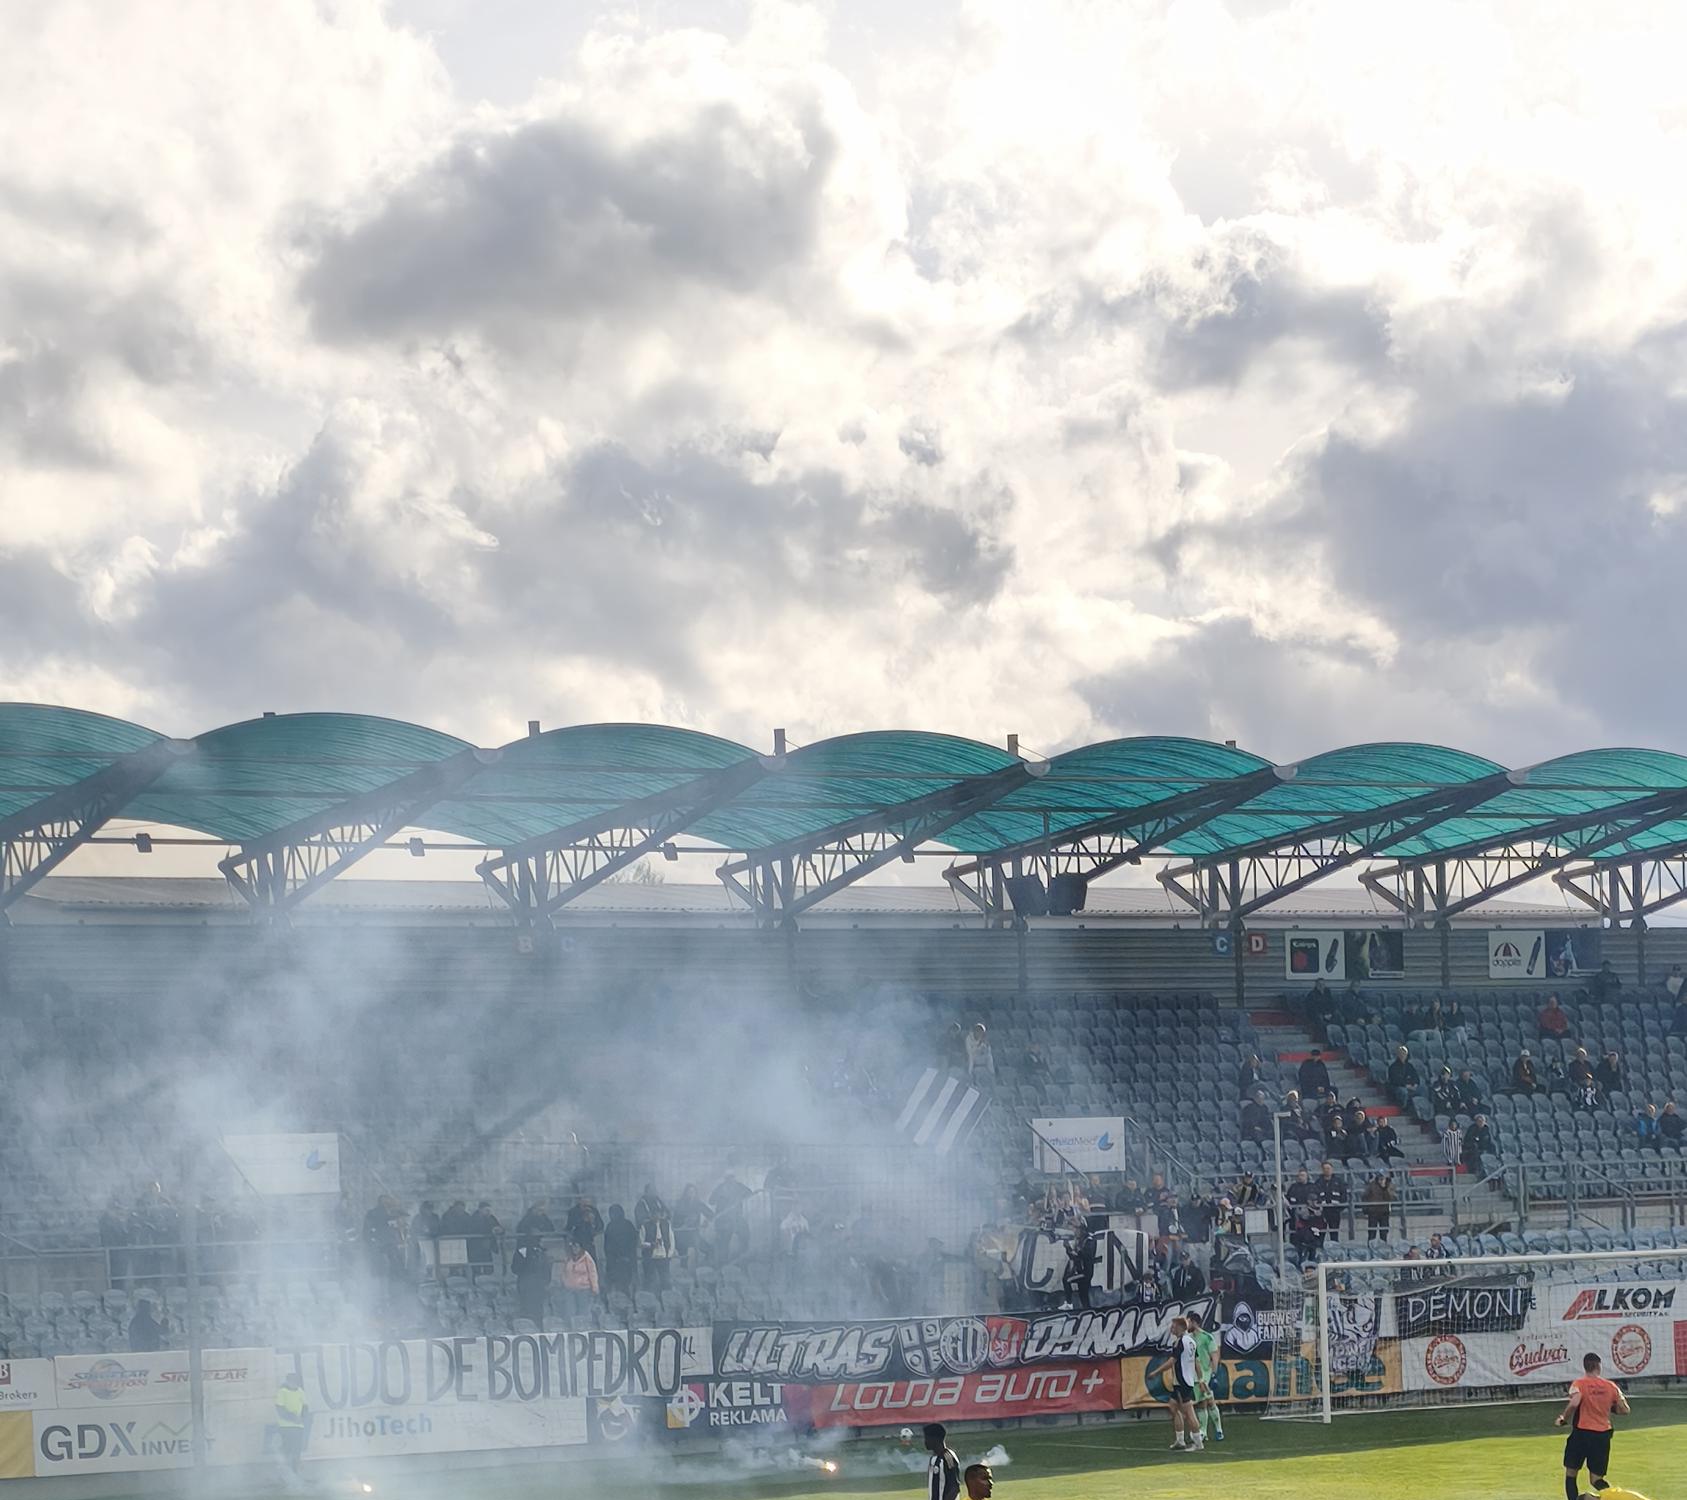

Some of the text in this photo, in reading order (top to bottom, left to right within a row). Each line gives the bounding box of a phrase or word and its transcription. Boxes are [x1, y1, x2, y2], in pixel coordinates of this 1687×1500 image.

[1215, 936, 1228, 953] C
[1251, 936, 1264, 953] D
[1407, 1285, 1522, 1323] DÉMONI
[1562, 1287, 1676, 1321] ALKOM
[720, 1323, 897, 1378] ULTRAS
[274, 1340, 411, 1410] TUDO
[425, 1337, 478, 1402] DE
[709, 1381, 786, 1408] KELT
[324, 1413, 433, 1439] JihoTech
[710, 1408, 788, 1426] REKLAMA
[40, 1421, 137, 1462] GDX
[142, 1439, 216, 1456] INVET
